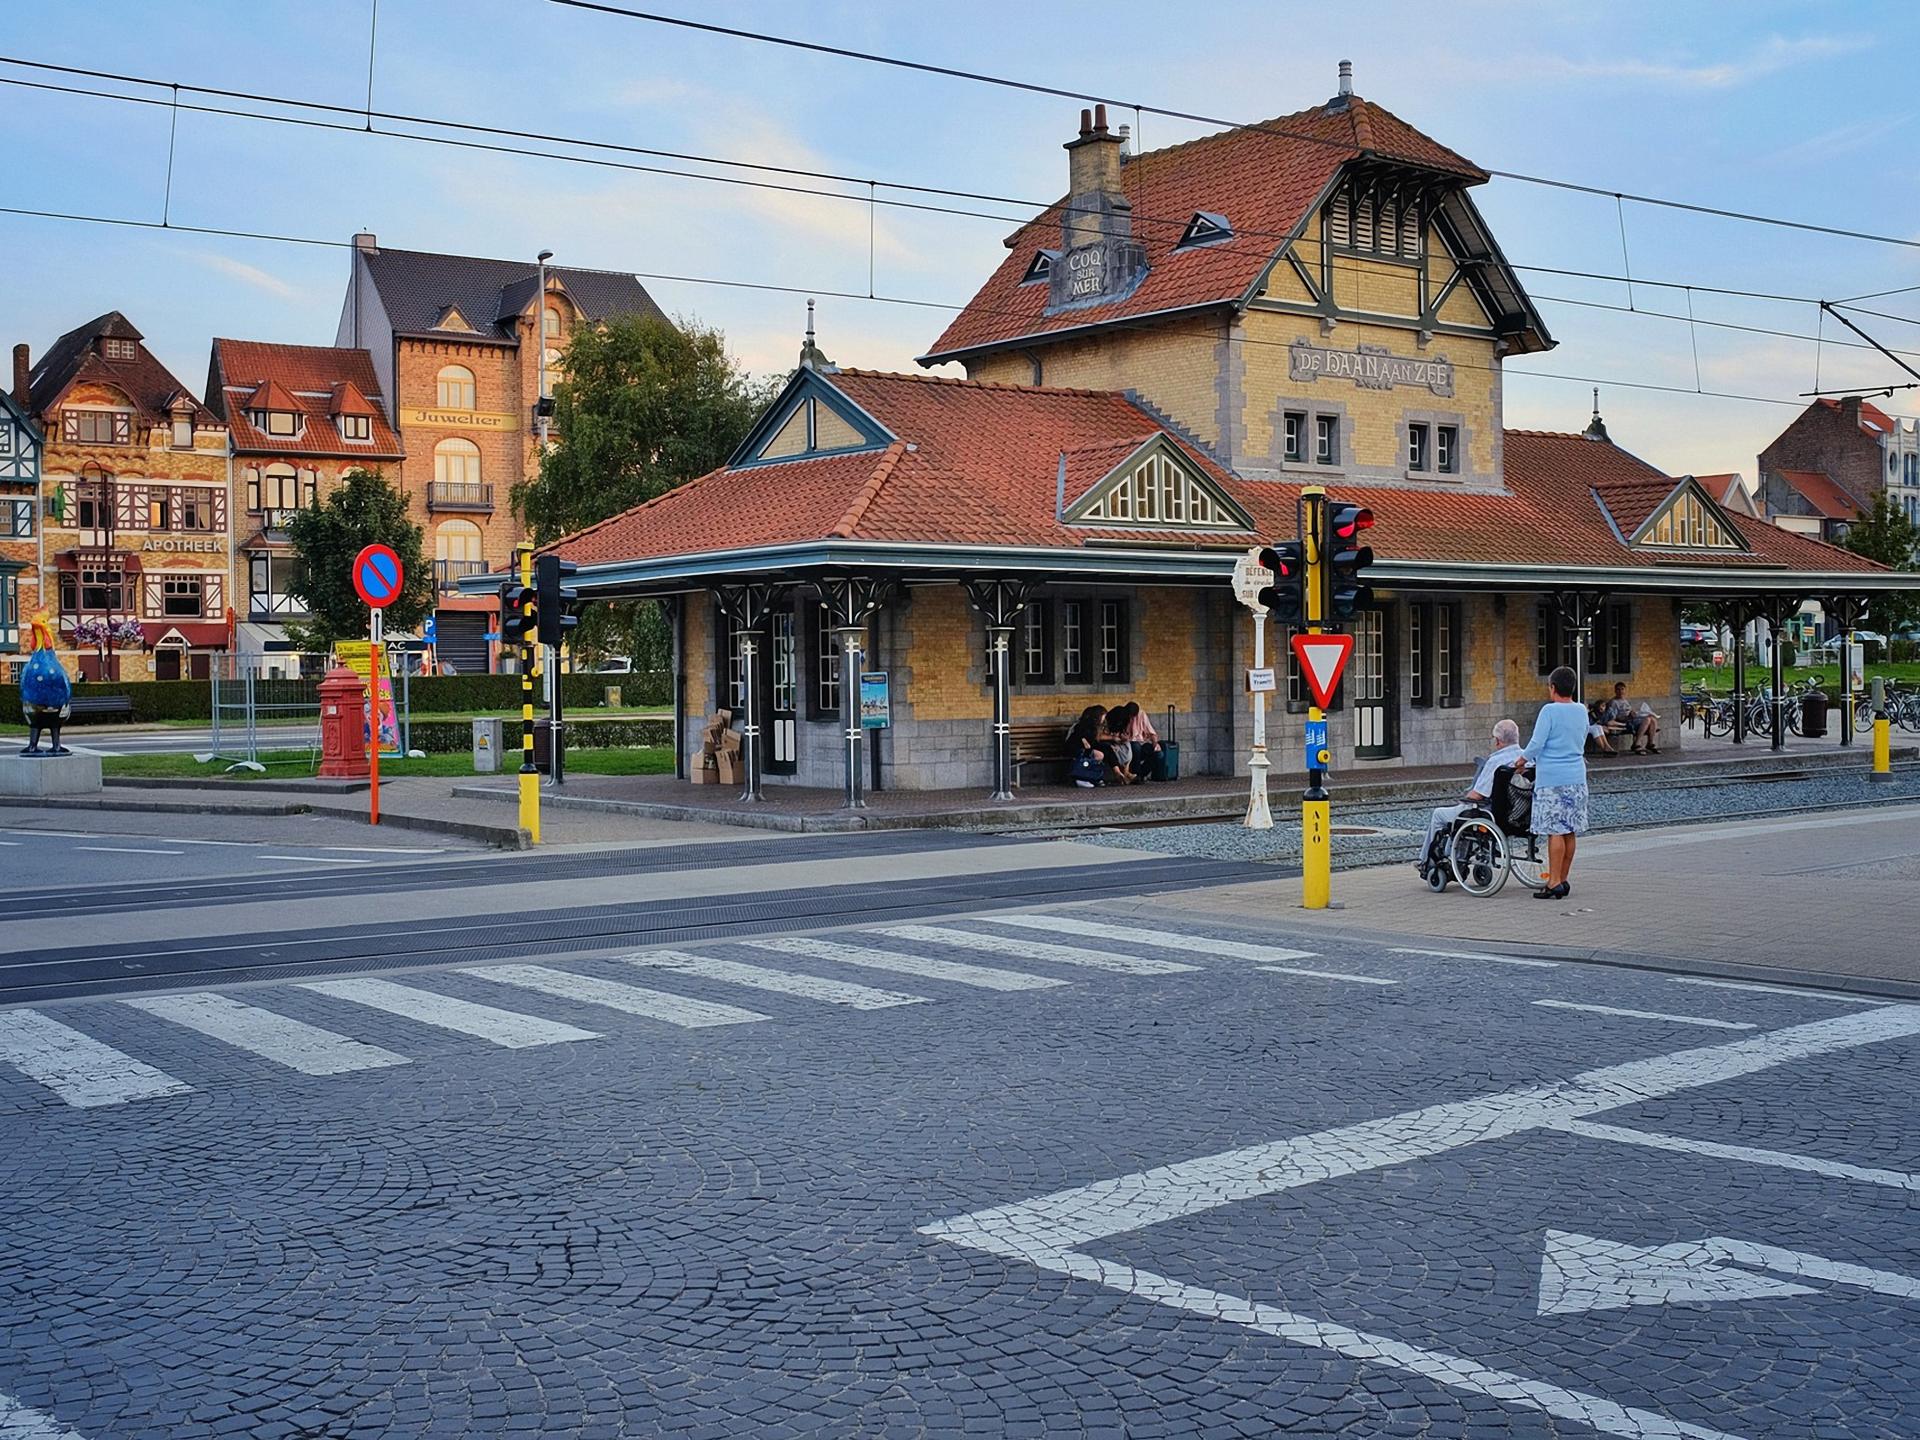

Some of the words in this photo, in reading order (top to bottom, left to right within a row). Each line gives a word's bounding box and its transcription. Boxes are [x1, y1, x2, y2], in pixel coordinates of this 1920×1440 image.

[1070, 250, 1101, 270] COQ
[1076, 268, 1096, 280] SUR
[1073, 277, 1101, 296] MER
[1300, 353, 1321, 371] DE
[1326, 350, 1378, 378] HAAN
[1378, 363, 1411, 381] AAN
[1414, 362, 1448, 385] ZEE
[415, 411, 501, 426] Juwelier
[142, 540, 224, 553] APOTHEEK
[425, 619, 433, 632] P
